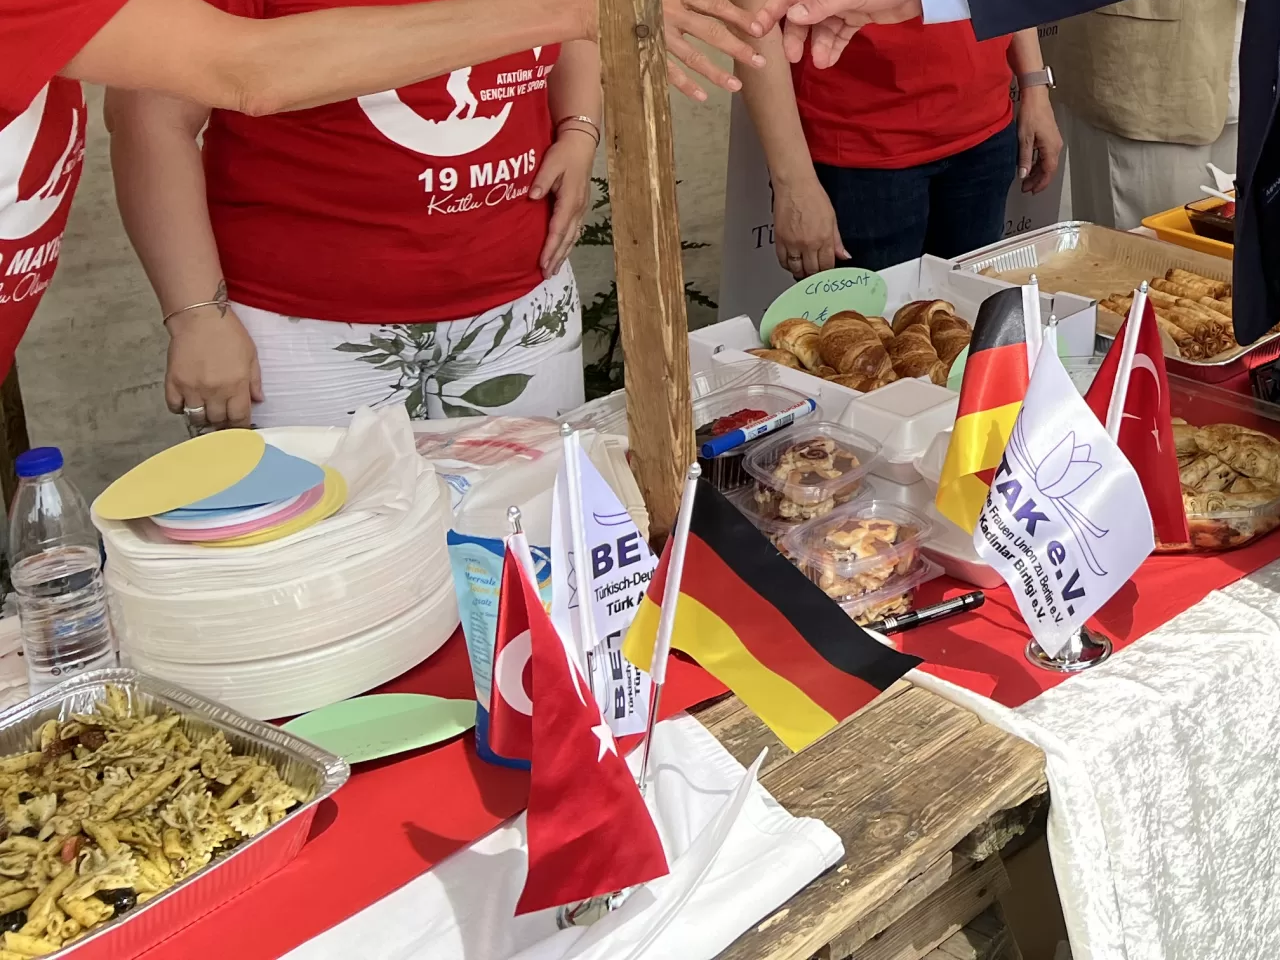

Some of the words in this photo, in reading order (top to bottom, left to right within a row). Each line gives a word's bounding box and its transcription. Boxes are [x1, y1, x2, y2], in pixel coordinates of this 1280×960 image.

[496, 68, 533, 86] ATATÜRK
[418, 167, 458, 193] 19
[469, 148, 536, 189] MAYIS
[427, 192, 483, 216] Kutlu
[594, 566, 656, 603] Türkisch-Deut
[989, 501, 1015, 542] Frauen
[1012, 535, 1038, 564] Union
[1034, 559, 1043, 579] zu
[1039, 572, 1054, 606] Berlin
[1049, 600, 1064, 627] e.V.
[1046, 539, 1087, 617] e.V.
[606, 596, 635, 617] Türk
[1012, 557, 1037, 599] Birligi
[1031, 597, 1047, 624] e.V.
